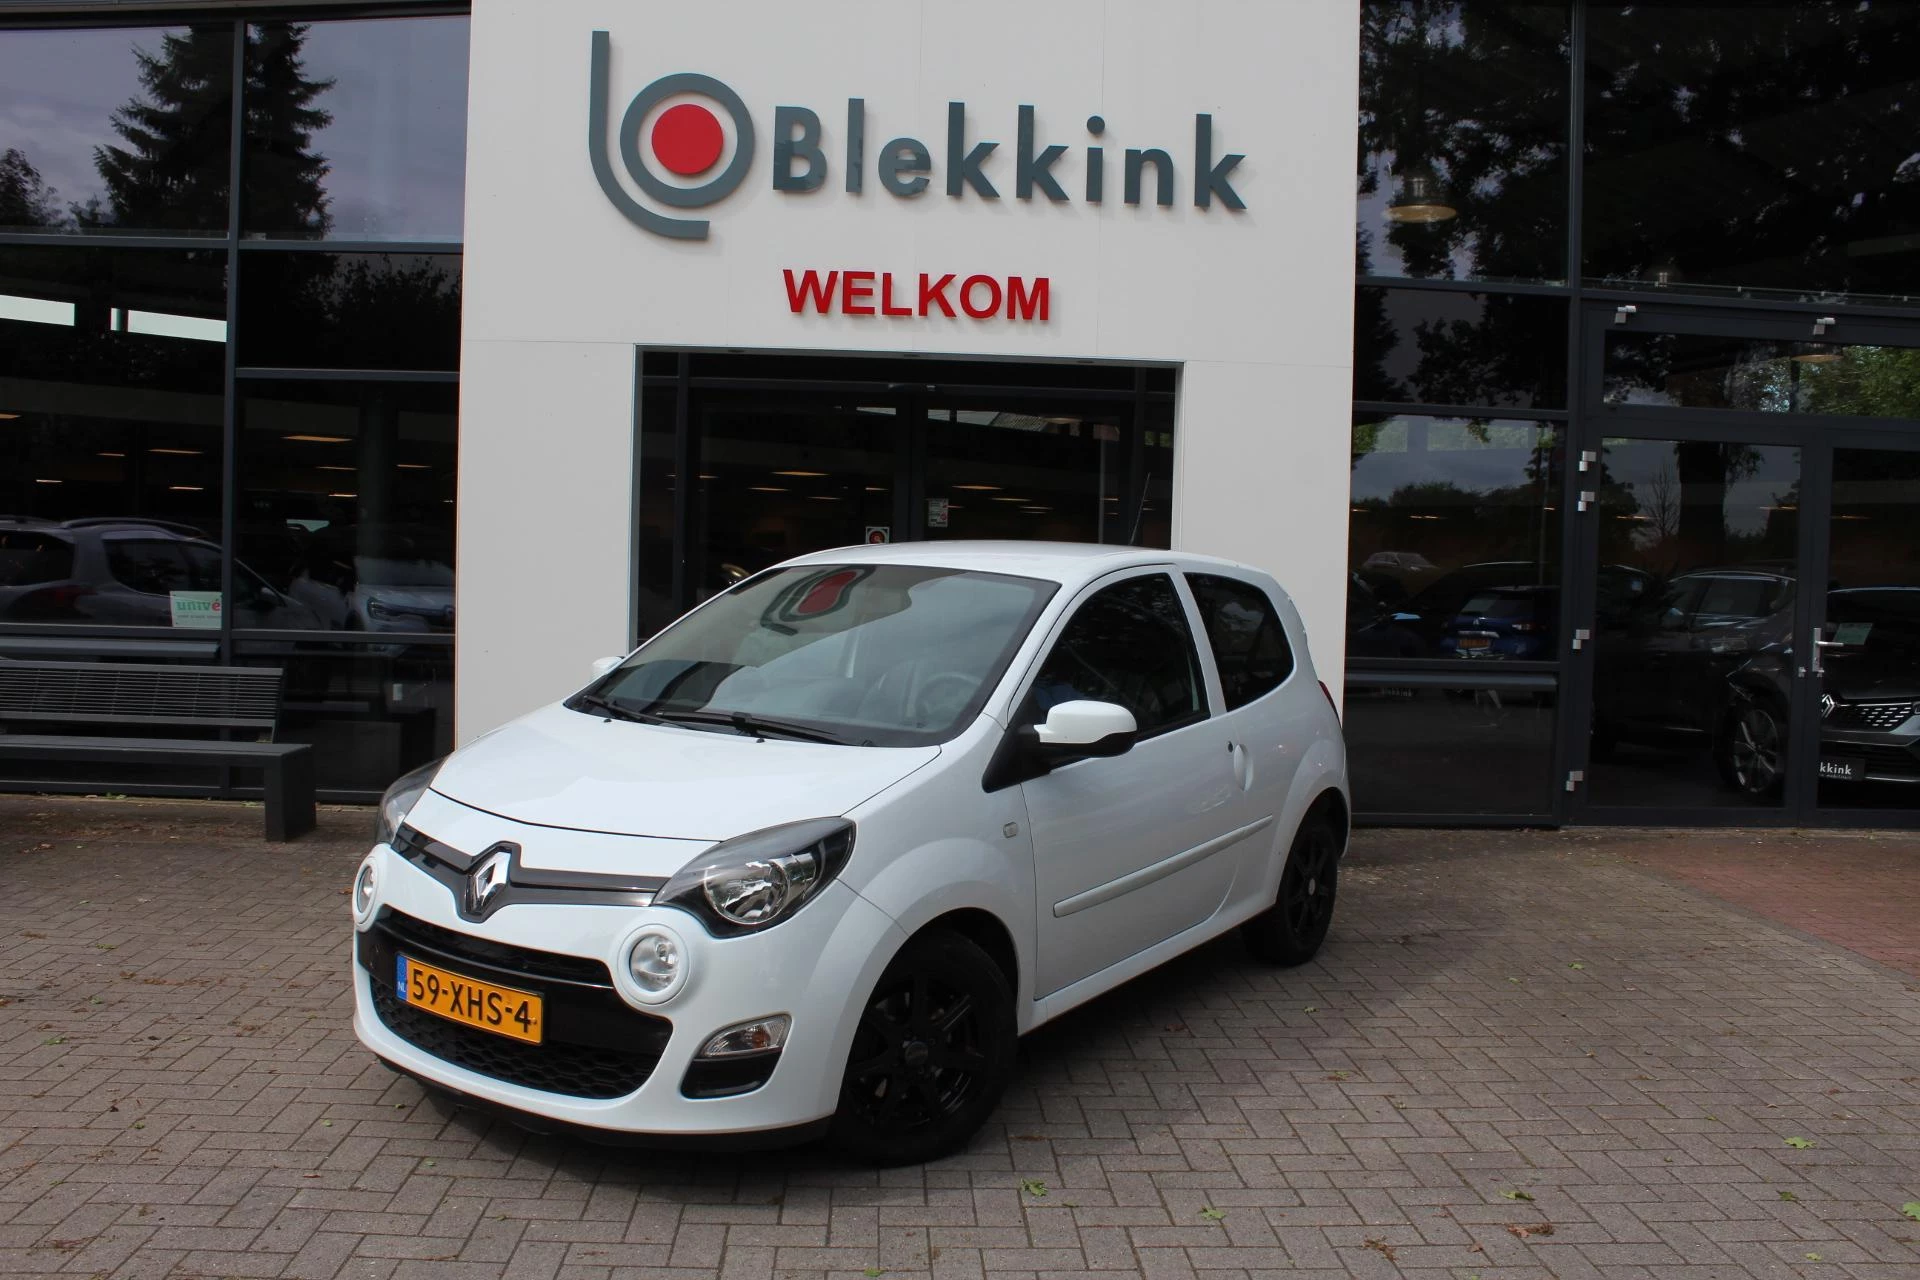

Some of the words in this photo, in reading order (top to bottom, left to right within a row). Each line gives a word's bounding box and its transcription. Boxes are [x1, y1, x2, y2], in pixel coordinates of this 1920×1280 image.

[772, 97, 1247, 211] Blekkink
[782, 268, 1051, 322] WELKOM
[397, 980, 407, 993] NL
[412, 967, 532, 1034] 59-XHS-4
